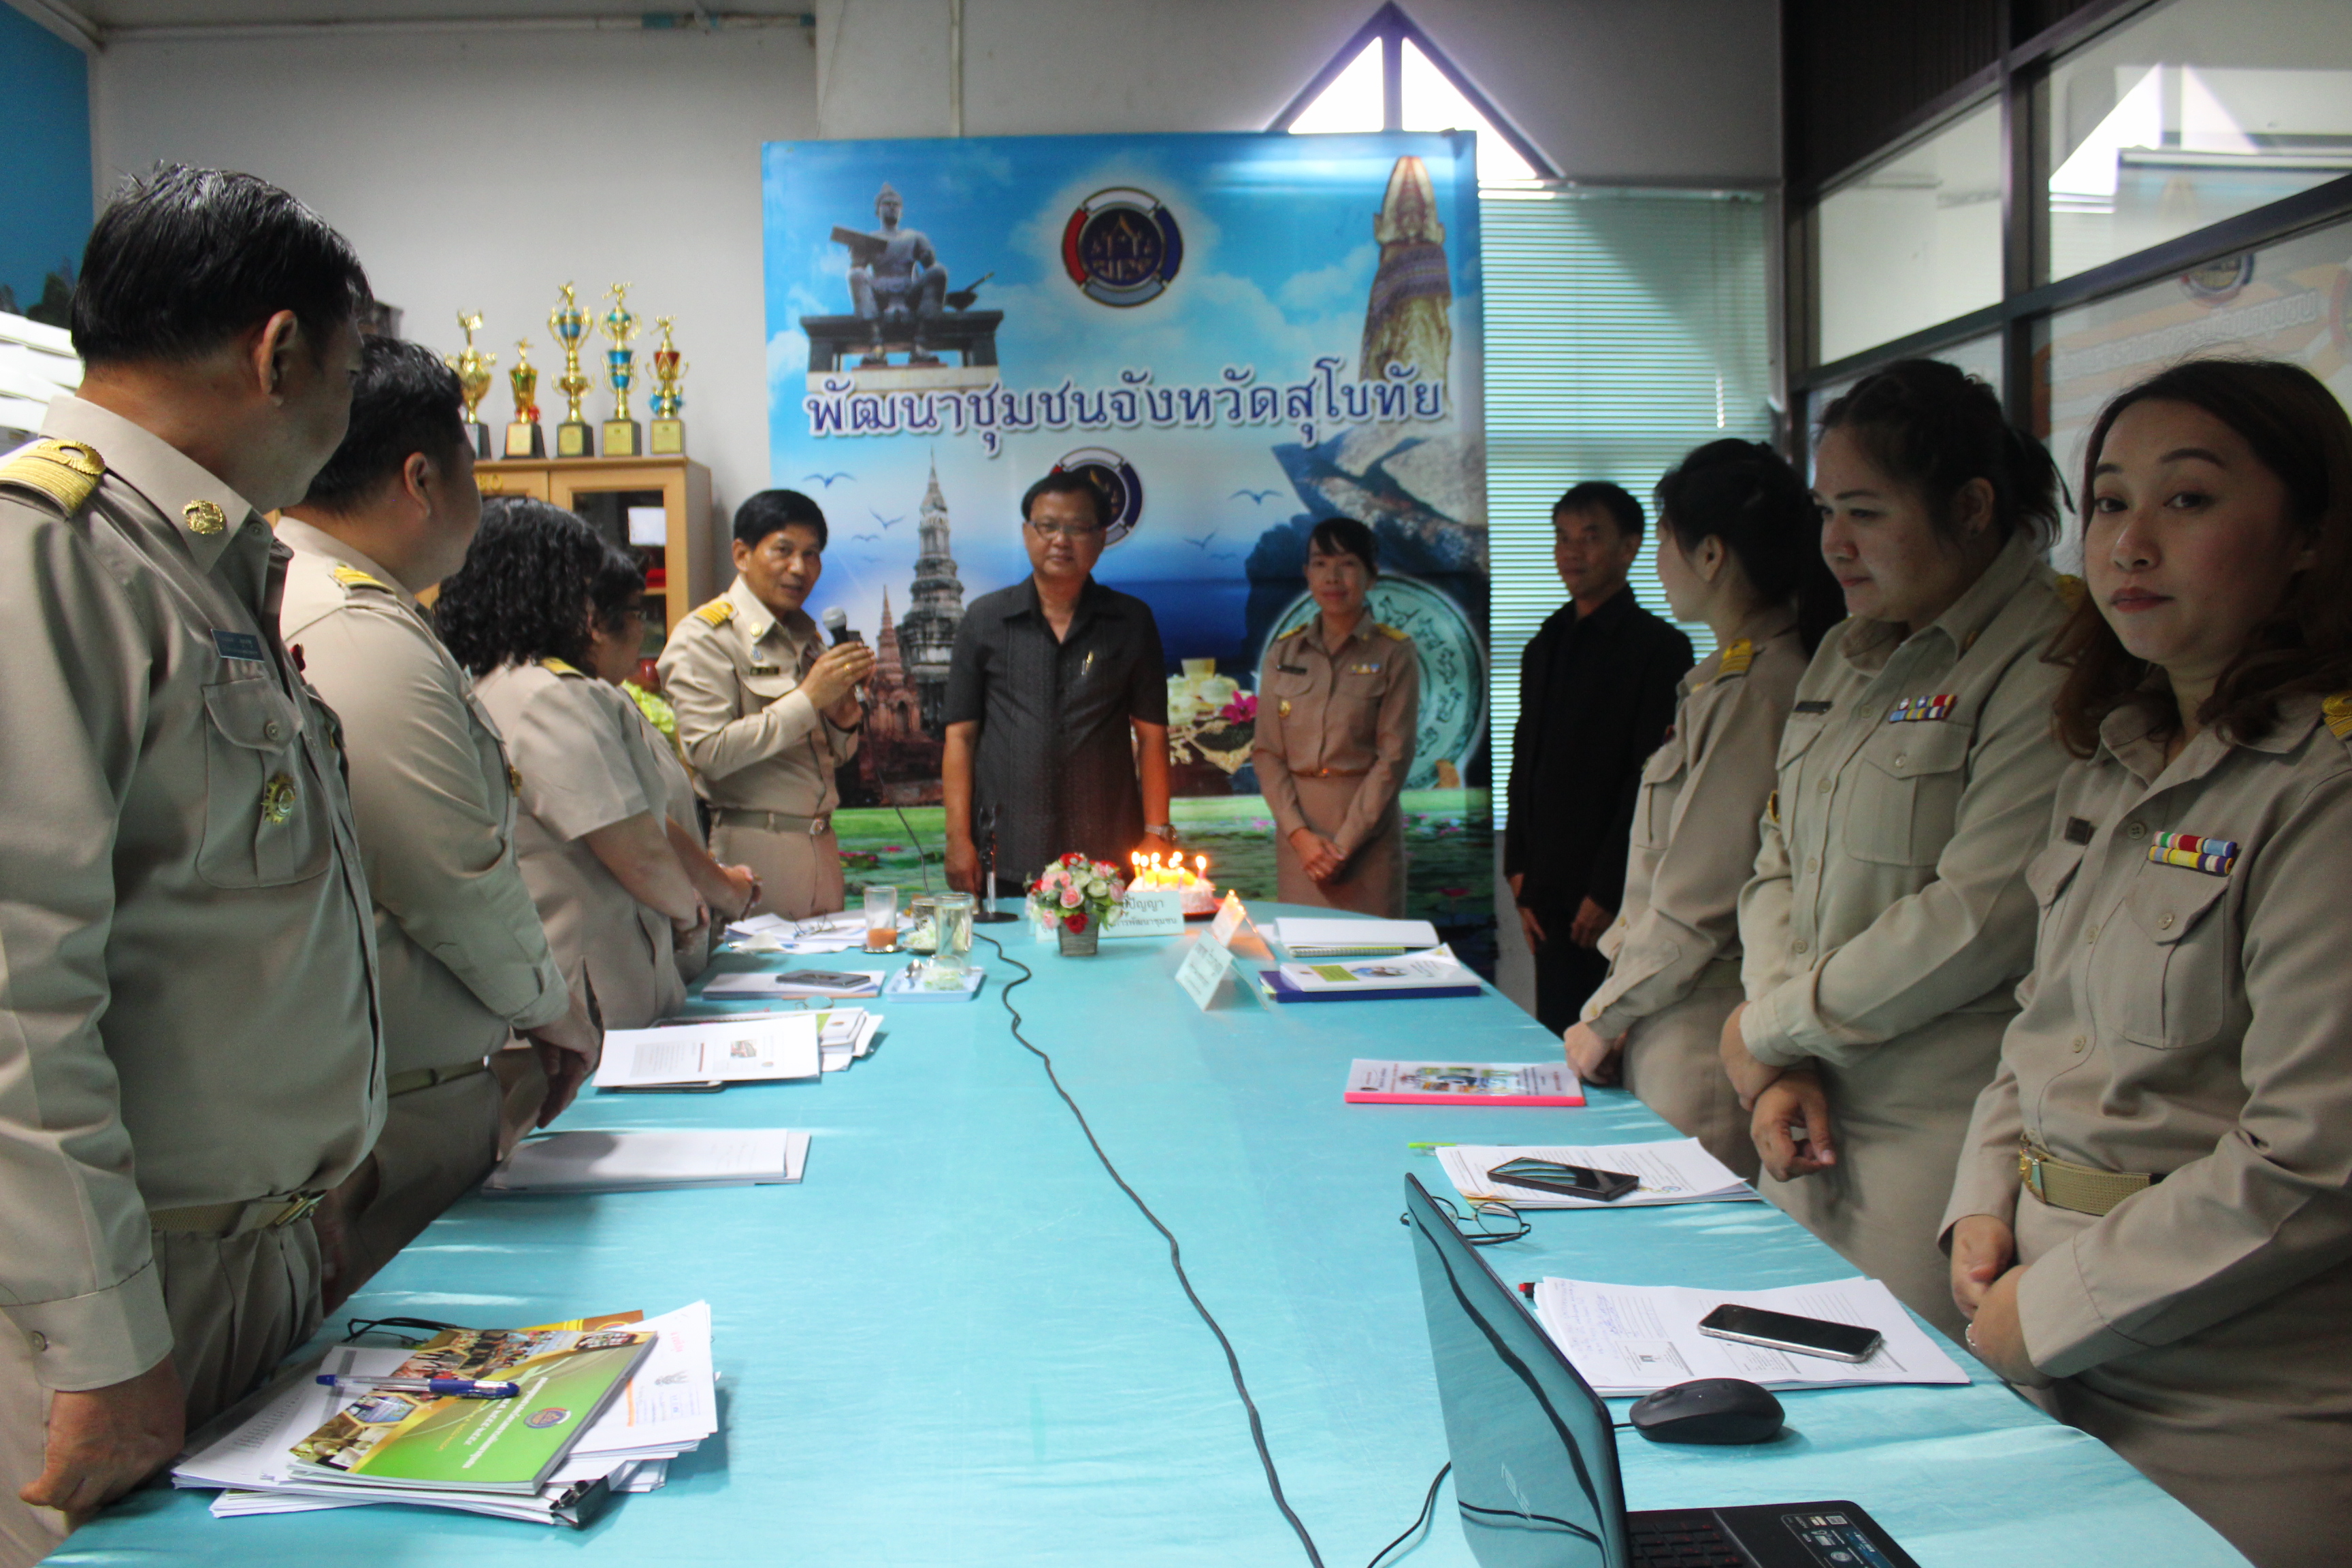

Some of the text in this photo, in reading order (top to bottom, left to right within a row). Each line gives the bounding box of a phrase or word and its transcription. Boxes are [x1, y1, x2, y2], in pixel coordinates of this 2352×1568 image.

[804, 355, 1444, 453] พัฒนาชุมชนจังหวัดสุโขทัย
